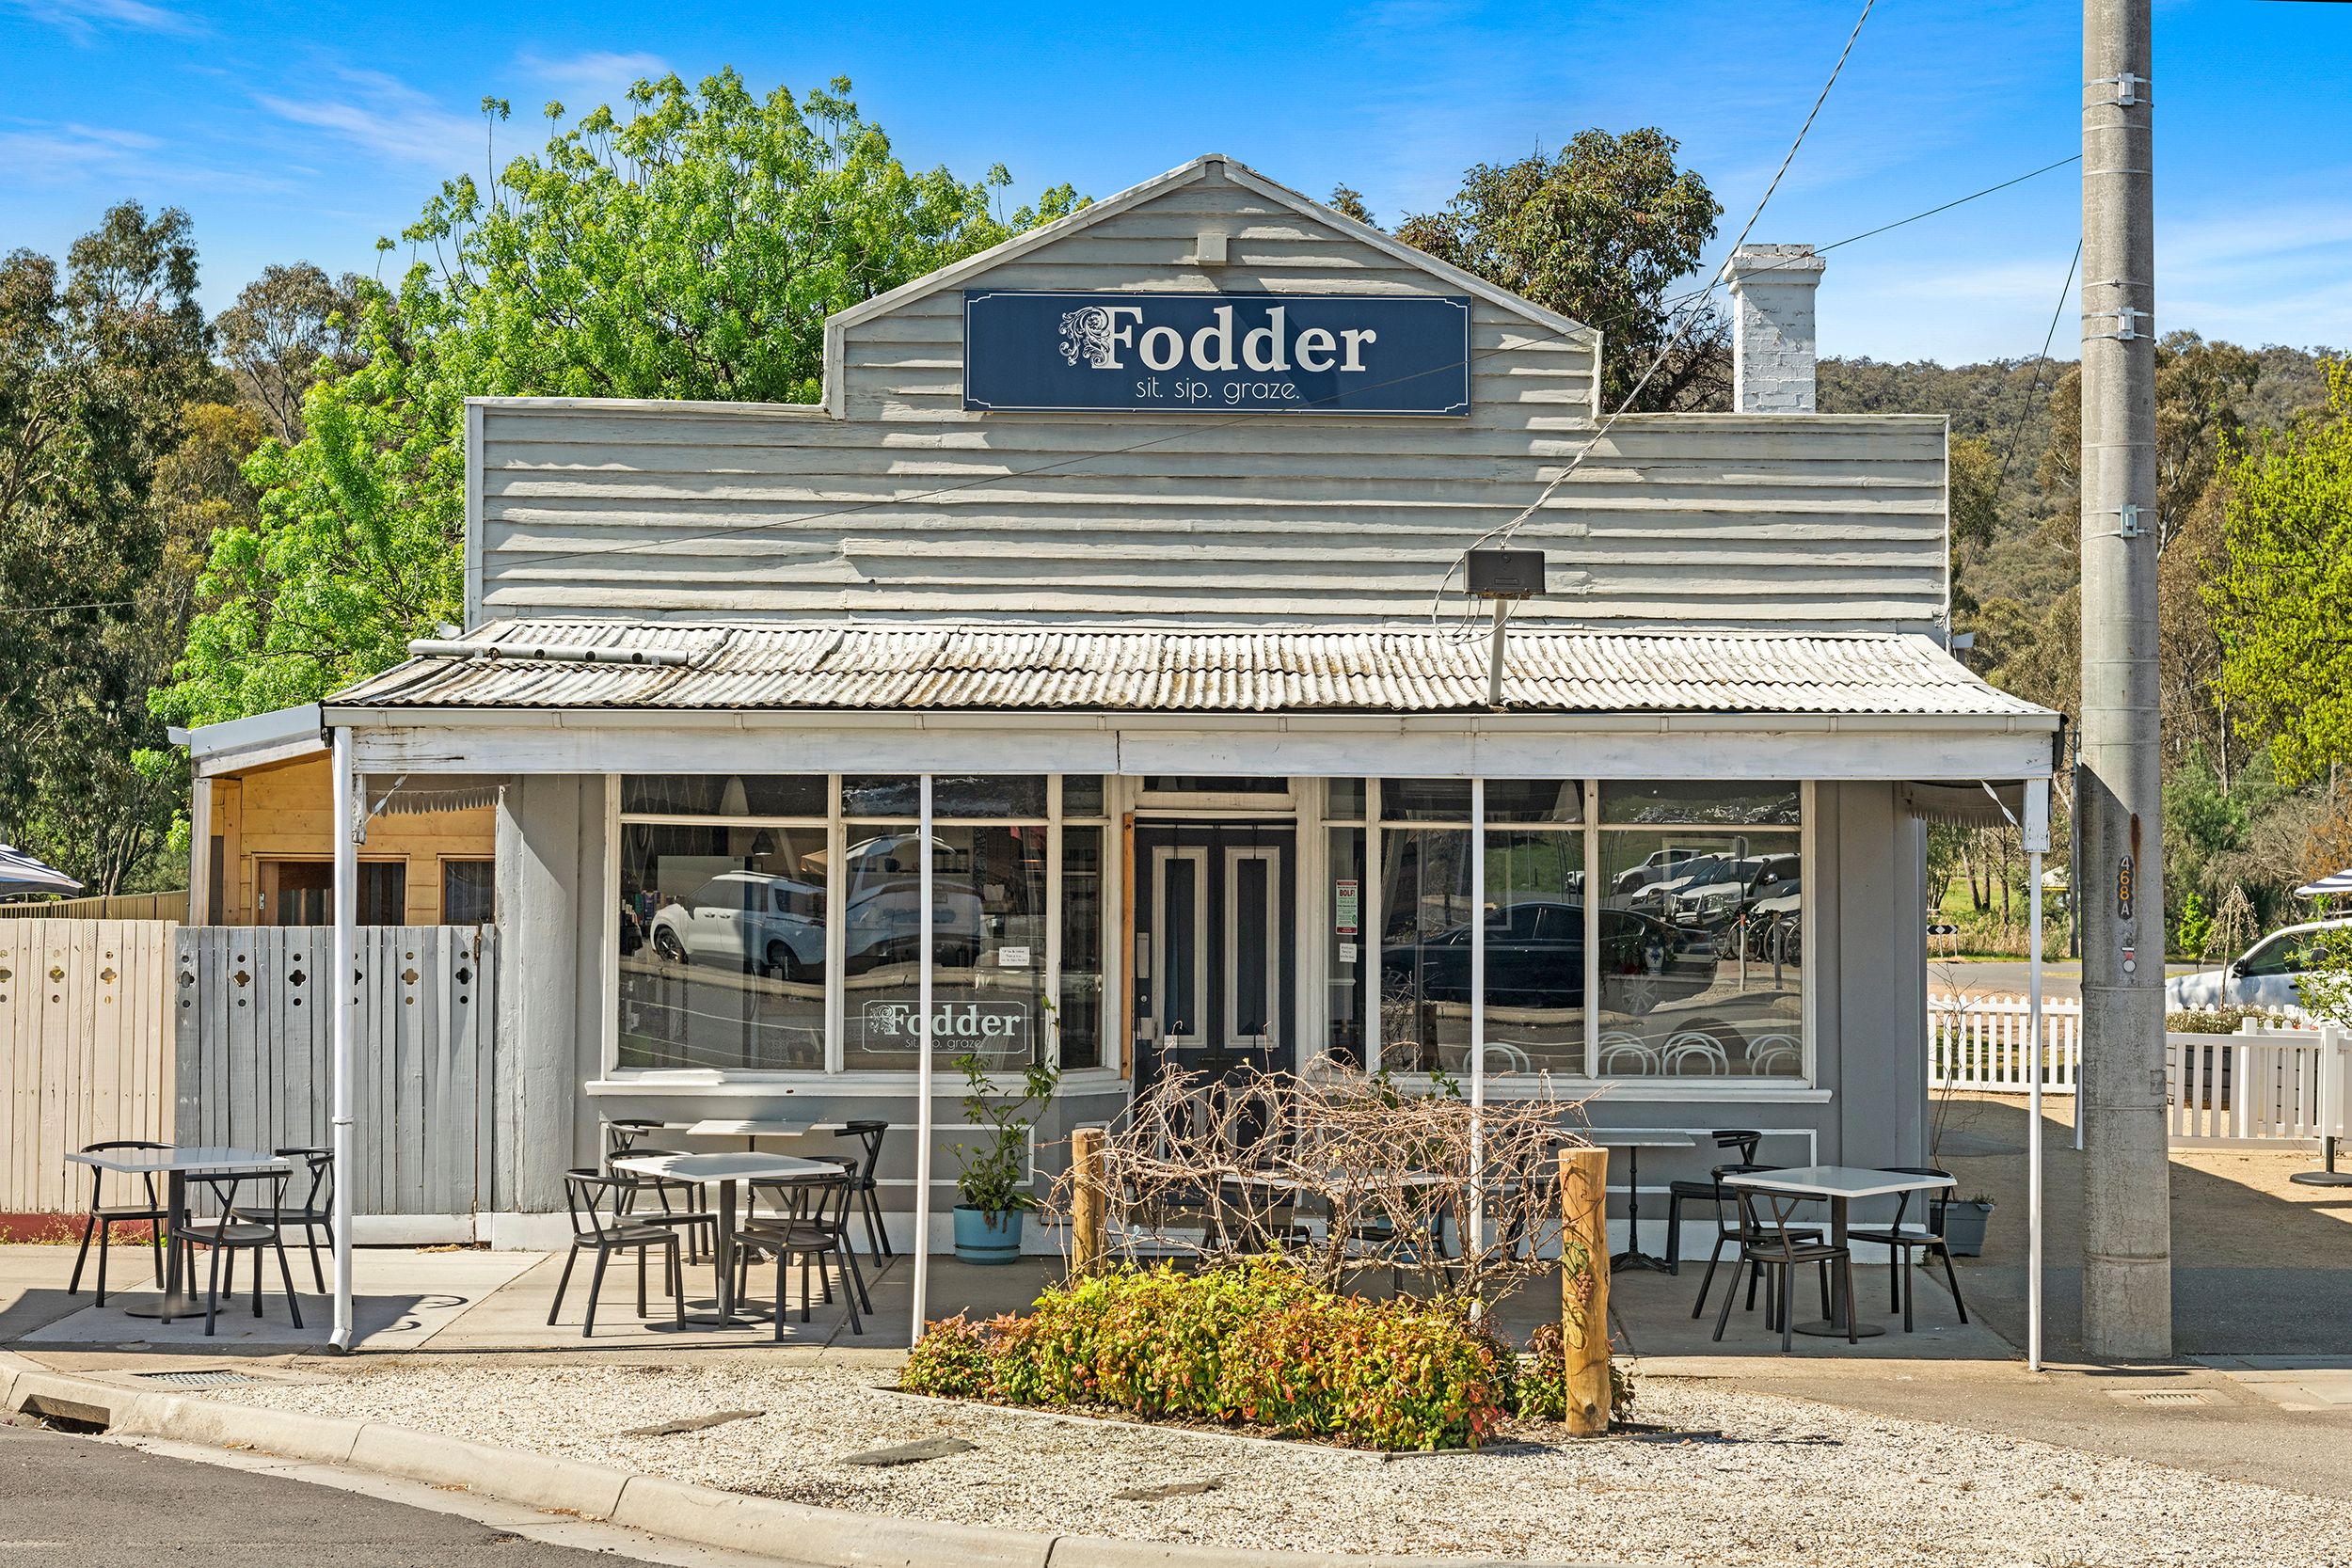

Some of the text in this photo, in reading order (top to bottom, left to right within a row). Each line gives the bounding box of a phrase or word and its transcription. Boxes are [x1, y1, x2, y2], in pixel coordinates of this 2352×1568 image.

[1091, 305, 1377, 372] Fodder
[1136, 376, 1300, 405] sit. sip. graze.
[2120, 856, 2131, 916] 468A
[882, 1004, 1022, 1037] Fodder
